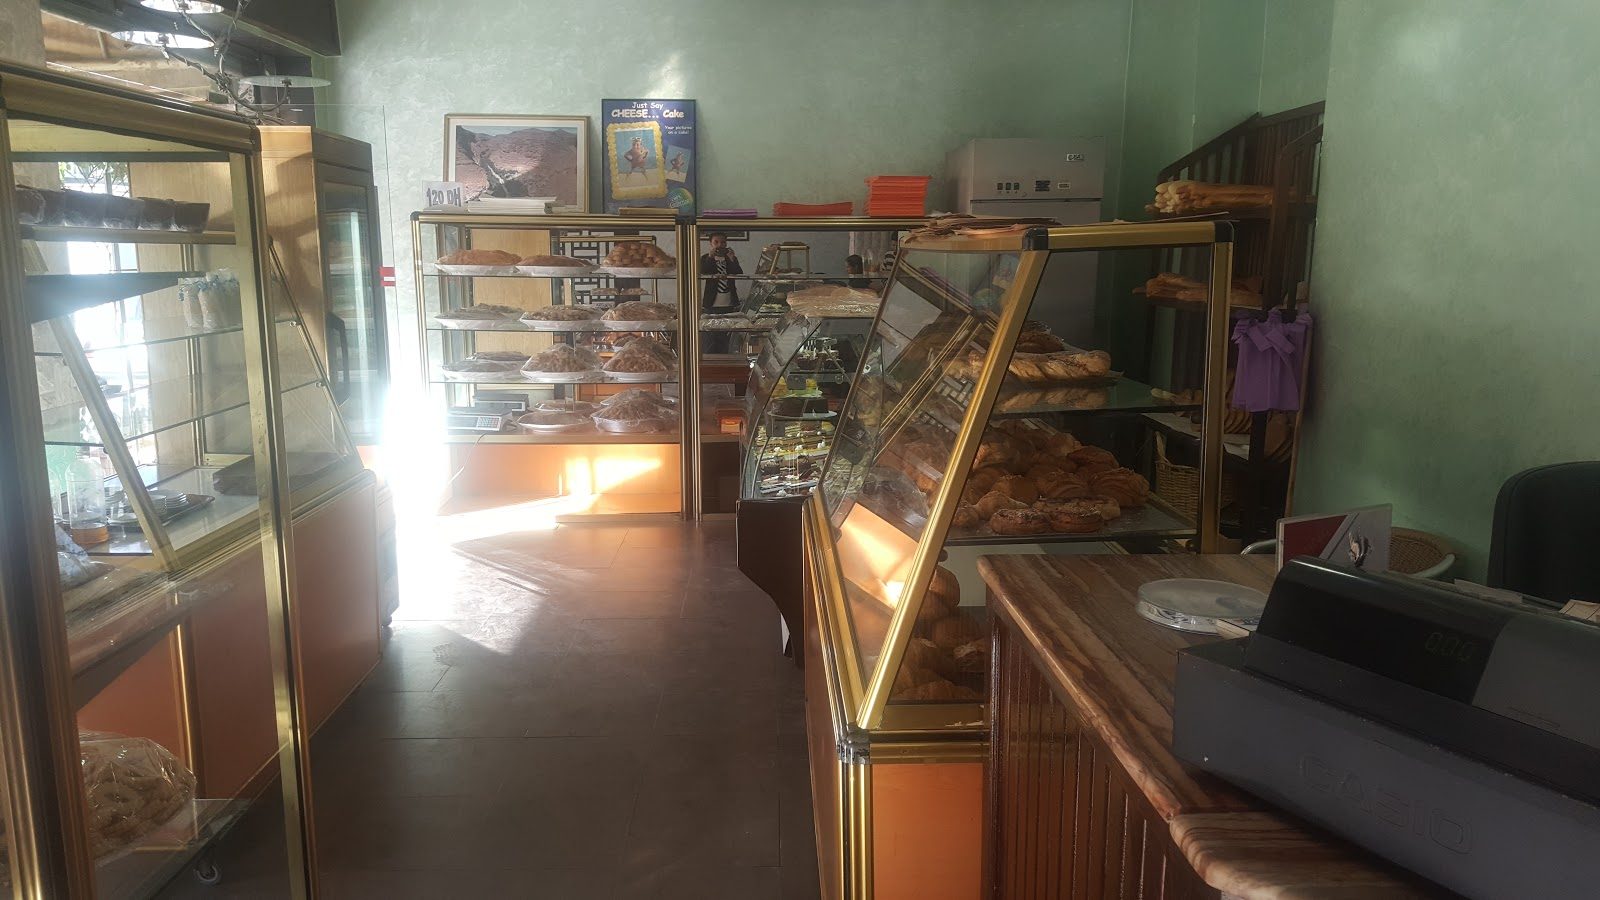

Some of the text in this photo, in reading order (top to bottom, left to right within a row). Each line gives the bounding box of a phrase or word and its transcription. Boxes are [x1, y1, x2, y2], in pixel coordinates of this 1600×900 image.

[611, 108, 685, 118] CHEESE... Cake
[632, 101, 664, 110] Just Say
[426, 187, 462, 207] 120 DH
[1297, 752, 1473, 855] CASIO
